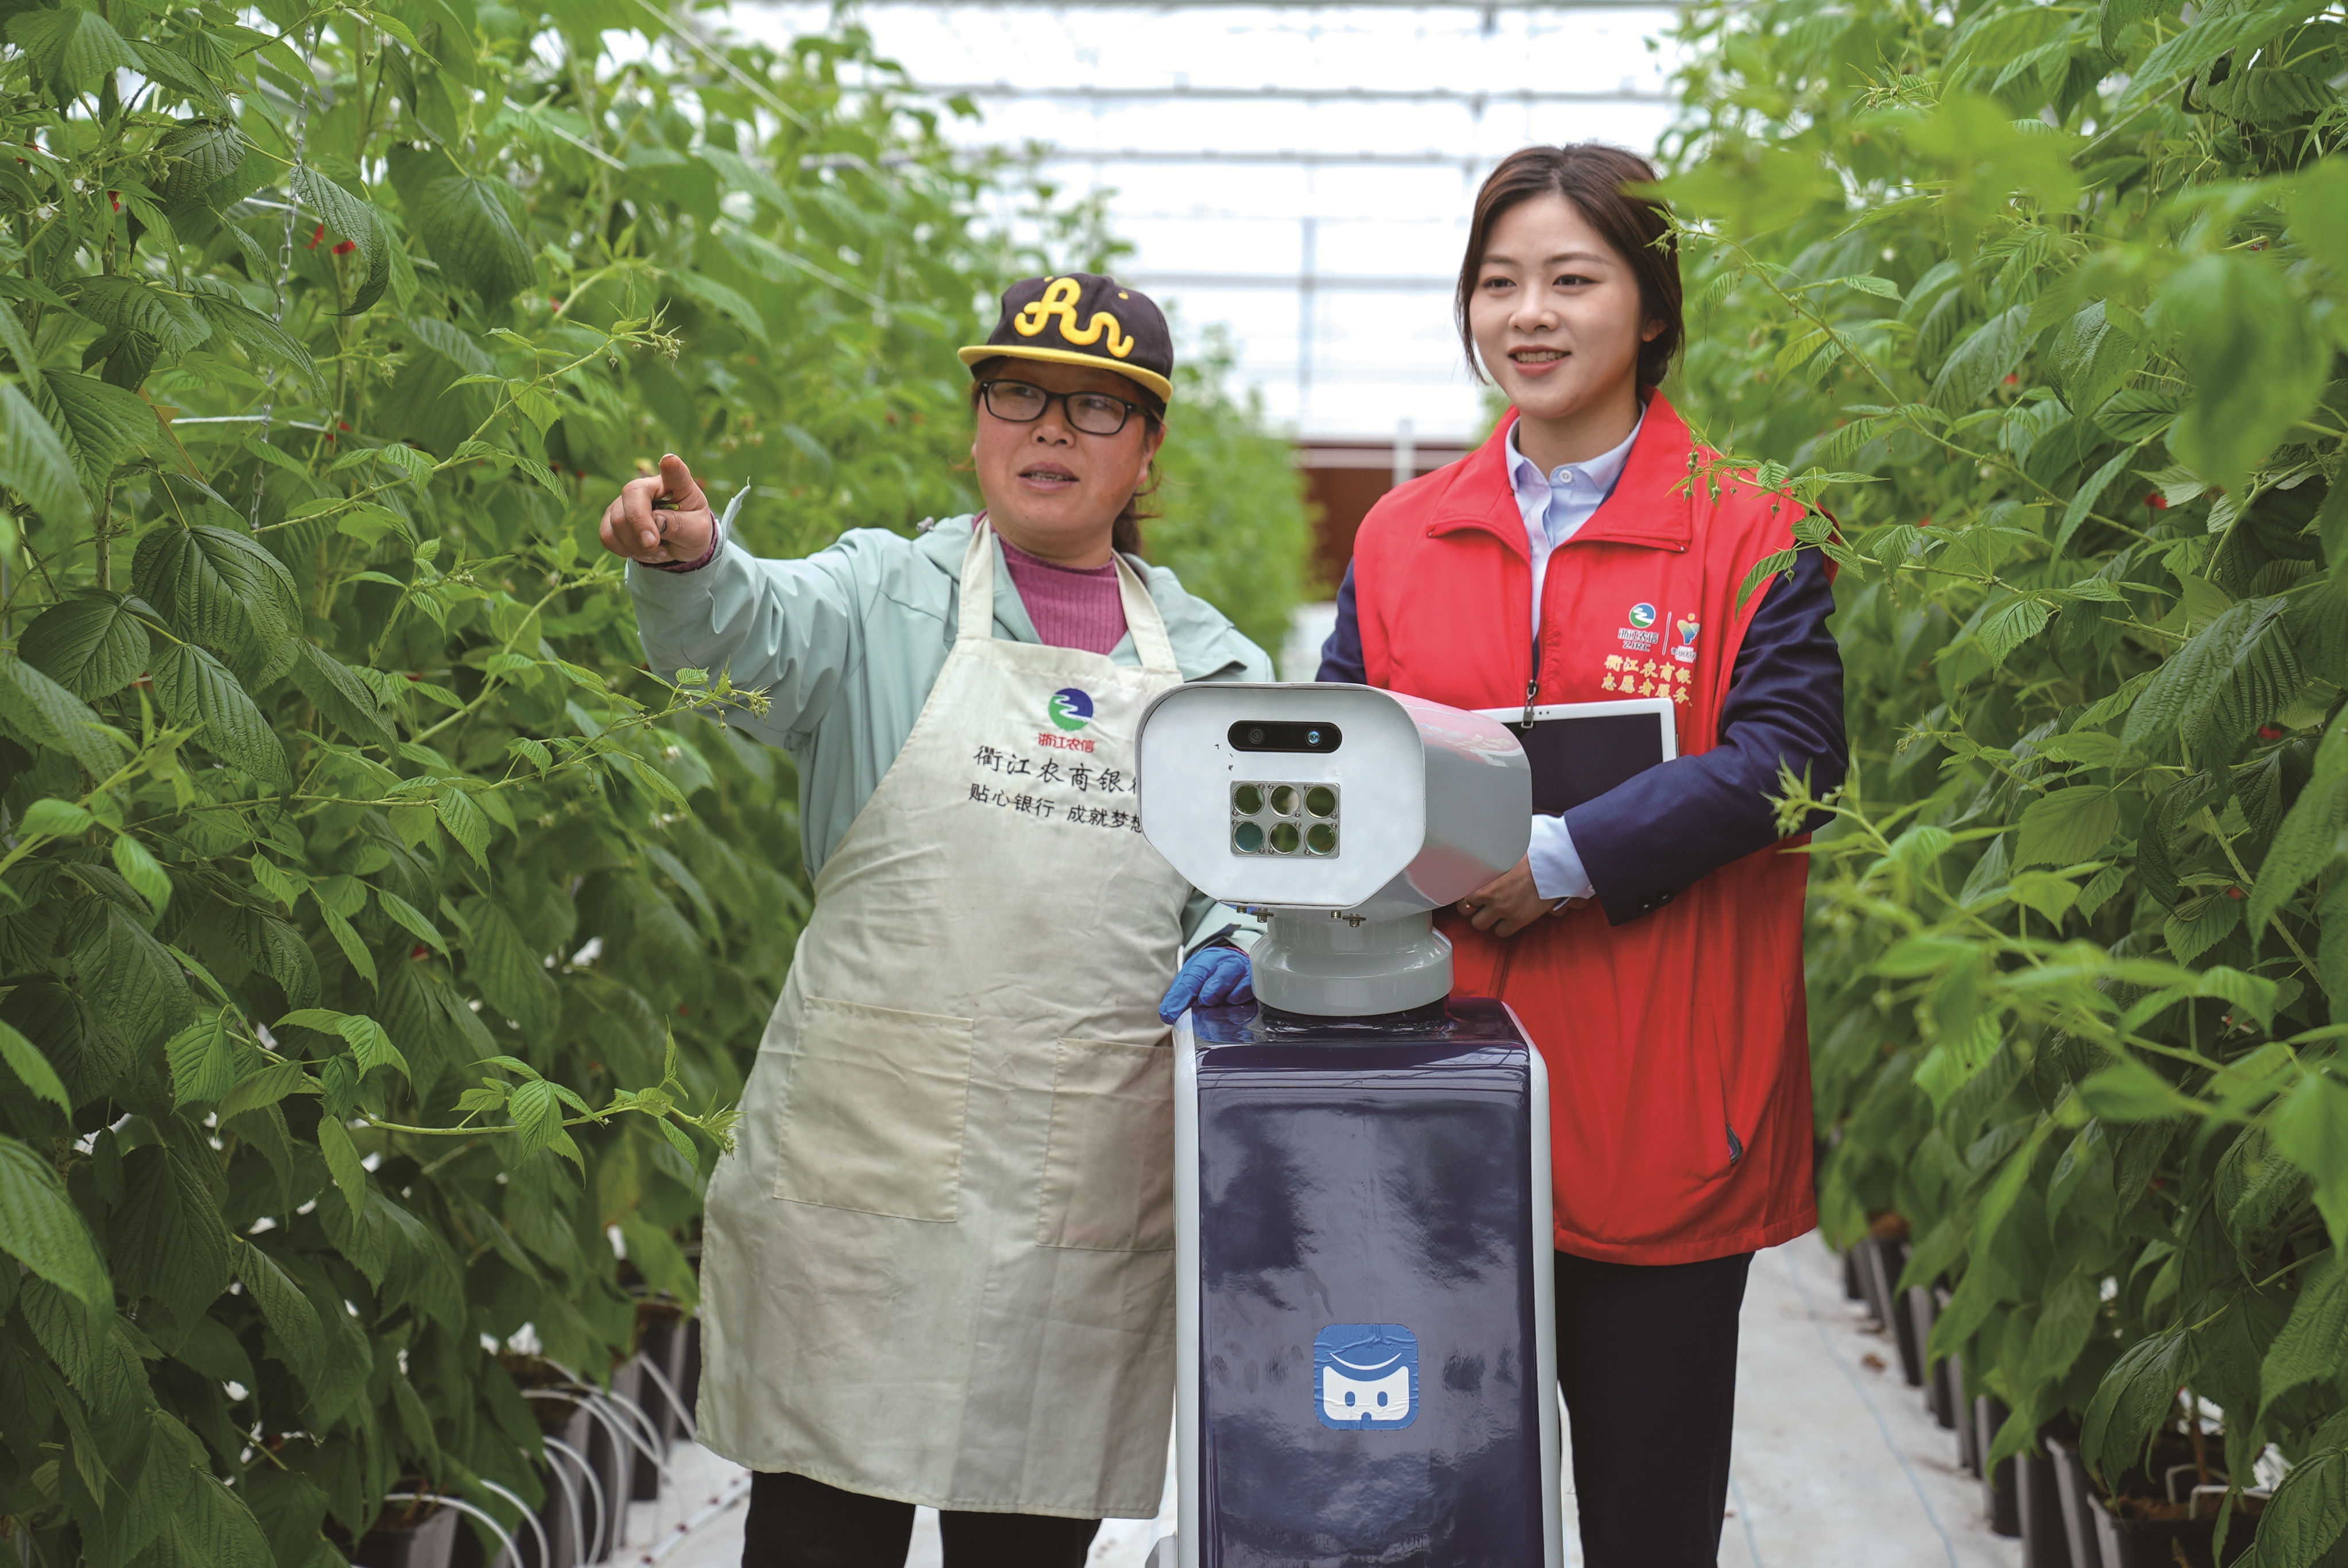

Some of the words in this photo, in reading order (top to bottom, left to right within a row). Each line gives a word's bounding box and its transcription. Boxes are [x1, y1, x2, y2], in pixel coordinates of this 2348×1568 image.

[1618, 628, 1659, 644] 浙江农信
[1623, 641, 1651, 652] ZJRC
[1601, 672, 1693, 706] 志愿者服务
[1038, 732, 1095, 754] 浙江农信
[969, 783, 1055, 817] 贴心银行
